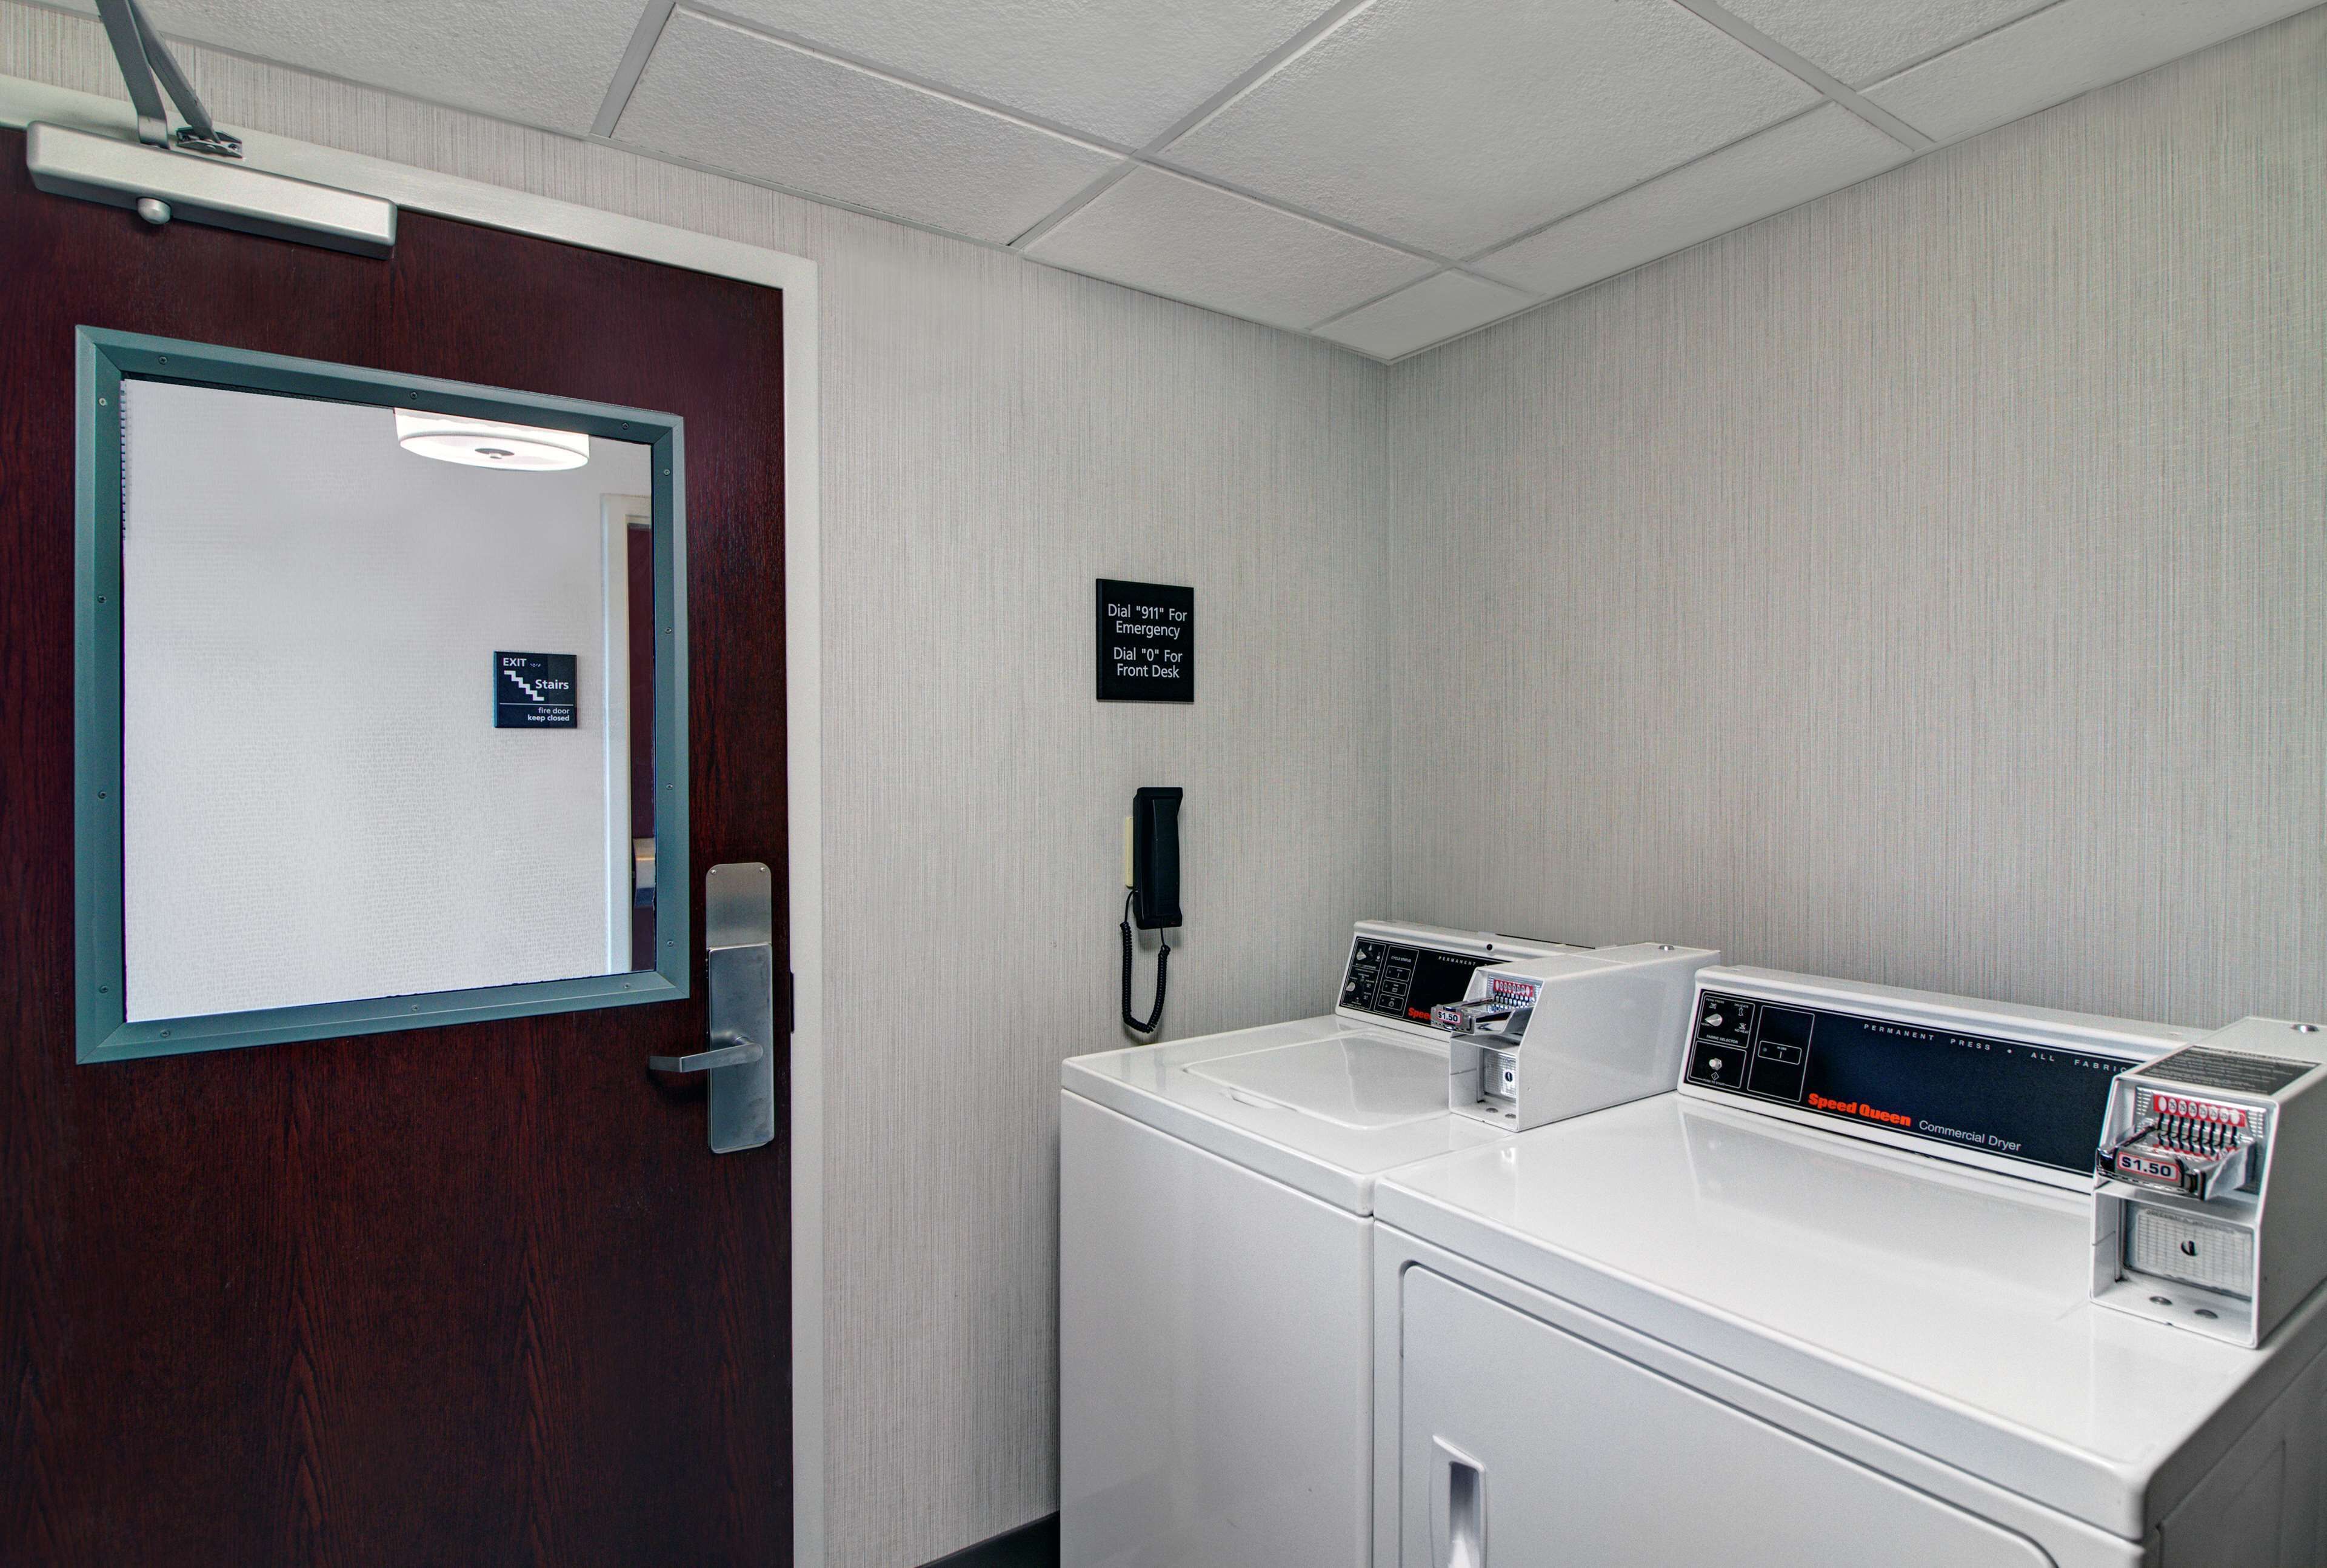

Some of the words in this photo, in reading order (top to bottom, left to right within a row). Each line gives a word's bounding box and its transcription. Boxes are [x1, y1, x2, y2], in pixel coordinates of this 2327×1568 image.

[1108, 603, 1130, 618] Dial
[1136, 606, 1164, 619] "911"
[1169, 608, 1187, 621] For
[1116, 620, 1180, 640] Emergency
[1113, 647, 1136, 661] Dial
[1141, 648, 1159, 661] "0"
[1164, 650, 1183, 662] For
[503, 658, 527, 667] EXIT
[1117, 663, 1149, 677] Front
[1152, 664, 1180, 678] Desk
[535, 679, 569, 690] Stairs
[1438, 956, 1476, 966] PERMANENT
[1408, 1007, 1431, 1021] Spee
[1438, 1011, 1458, 1022] $1.50
[1863, 1023, 1934, 1041] PERMANENT
[1950, 1038, 1991, 1050] PRESS
[2030, 1052, 2055, 1061] ALL
[1808, 1093, 1857, 1114] Speed
[1859, 1104, 1911, 1127] Queen
[1919, 1119, 1985, 1144] Commercial
[1988, 1135, 2022, 1151] Dryer
[2121, 1155, 2172, 1177] $1.50
